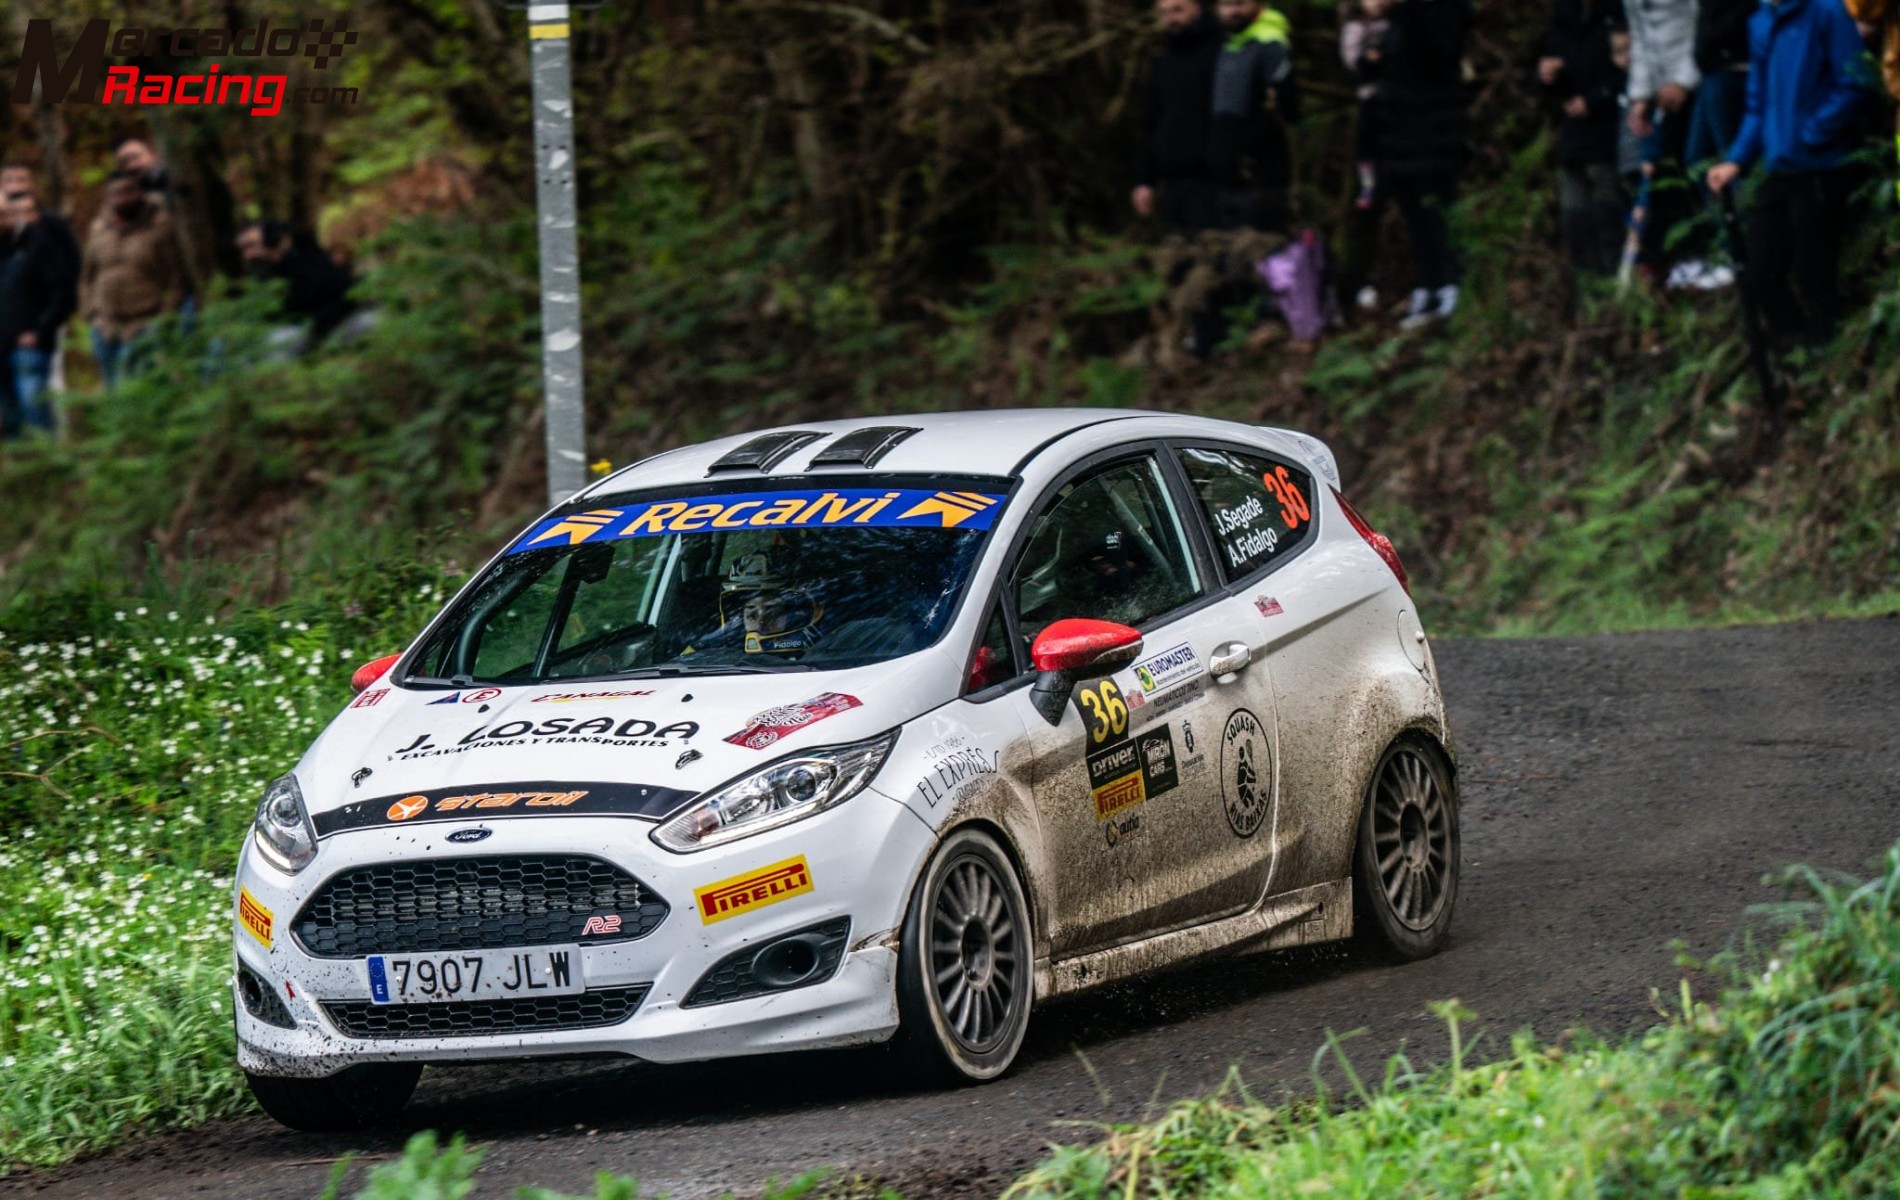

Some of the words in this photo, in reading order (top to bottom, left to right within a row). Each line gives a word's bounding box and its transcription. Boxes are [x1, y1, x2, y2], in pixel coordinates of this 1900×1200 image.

[620, 492, 900, 536] Recalvi
[1215, 496, 1263, 536] J.Segade
[1263, 465, 1310, 529] 36
[1228, 527, 1278, 568] A.Fidalgo
[1147, 647, 1196, 677] EUROMASTER
[1080, 680, 1127, 743] 36
[1227, 716, 1255, 746] SQUASH
[395, 733, 436, 754] J.
[457, 717, 700, 746] LOSADA
[400, 738, 526, 761] EXCAVACIONES
[532, 737, 543, 745] Y
[546, 736, 669, 748] TRANSPORTES
[917, 776, 943, 808] EL
[1096, 776, 1141, 815] PIRELLI
[701, 863, 807, 917] PIRELLI
[239, 892, 271, 941] PIRELLI
[582, 915, 622, 935] R2
[376, 984, 384, 995] E
[392, 957, 483, 995] 7907
[502, 951, 571, 990] JLW
